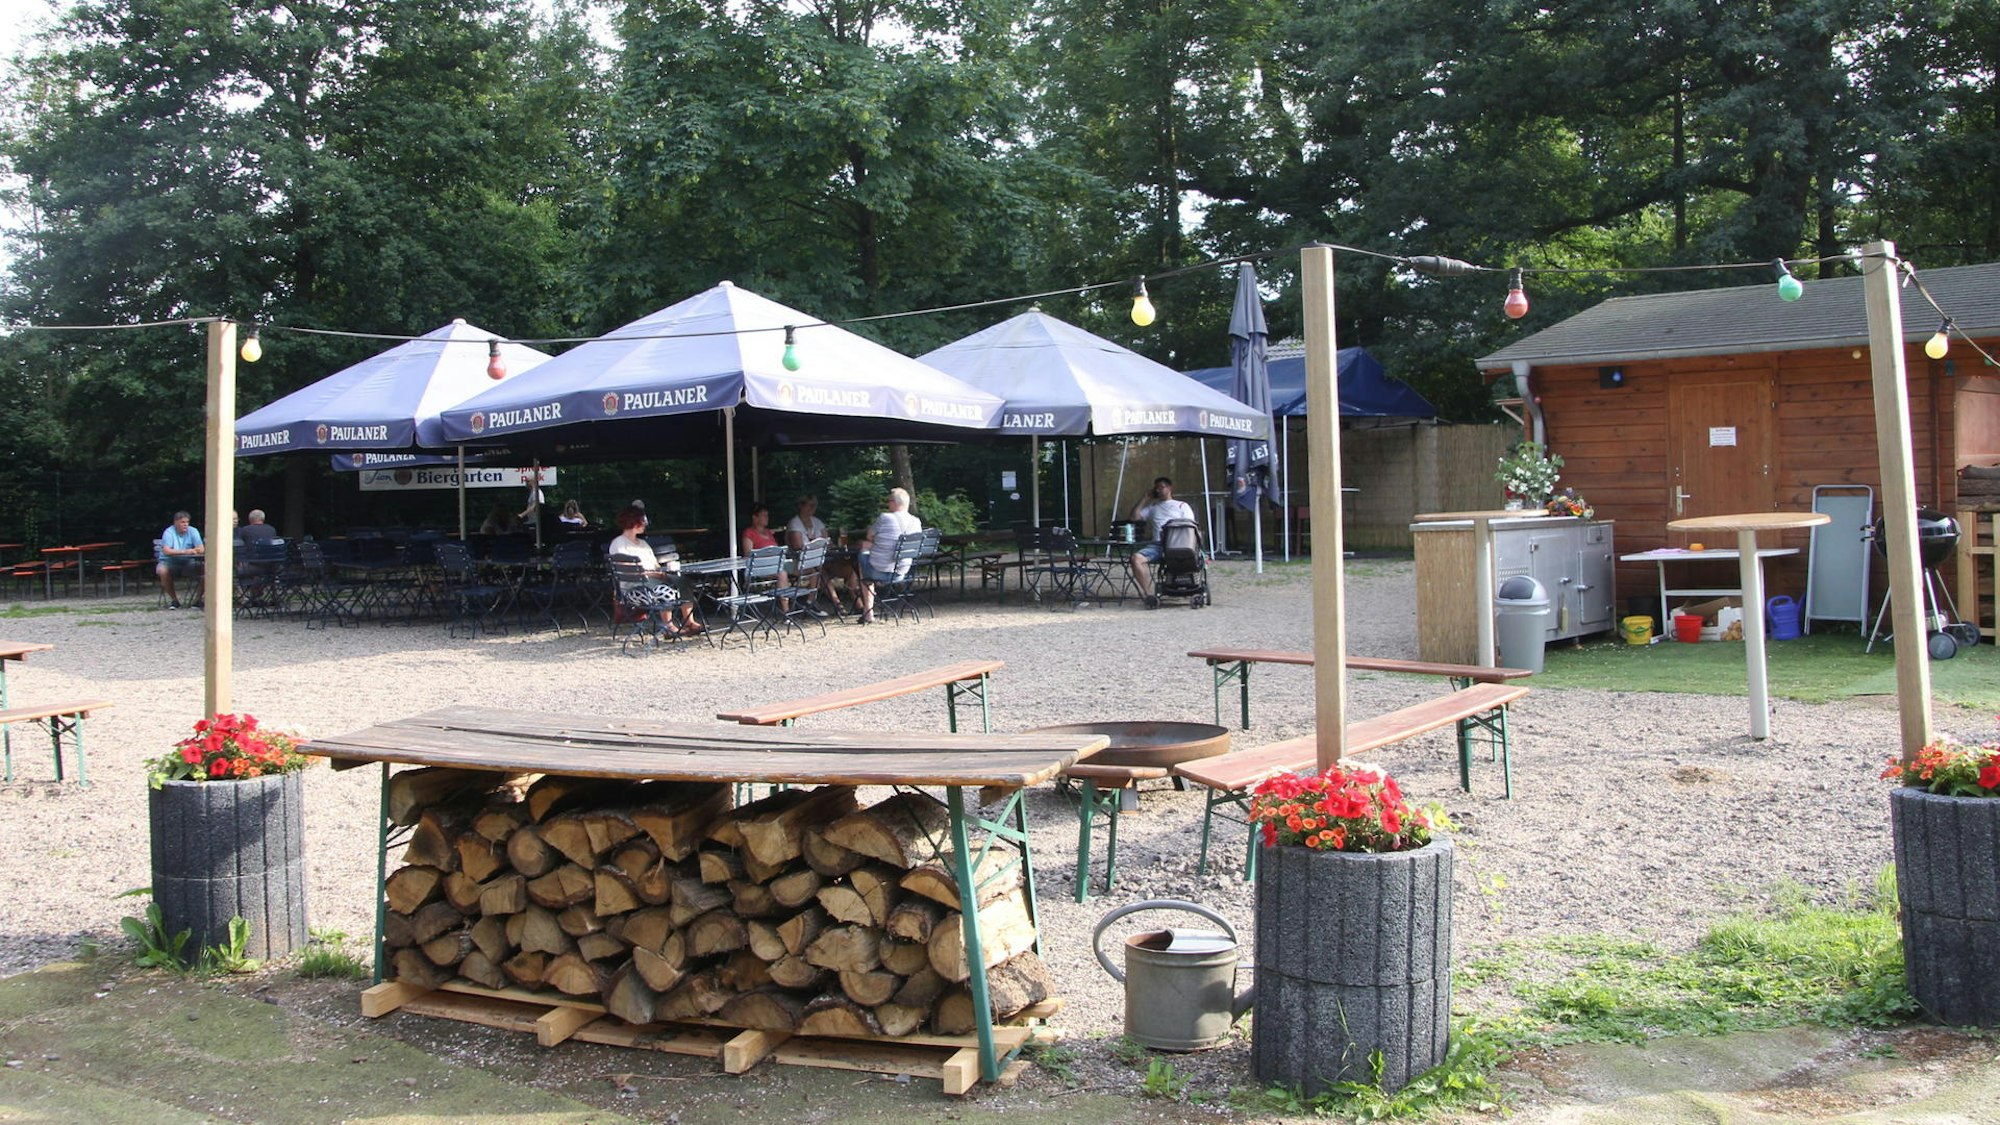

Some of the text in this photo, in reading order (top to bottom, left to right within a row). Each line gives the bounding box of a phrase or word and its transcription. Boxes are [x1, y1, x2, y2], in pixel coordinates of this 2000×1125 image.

[623, 384, 708, 411] PAULANER
[796, 385, 871, 408] PAULANER
[488, 402, 562, 429] PAULANER
[919, 399, 984, 421] PAULANER
[1003, 412, 1055, 428] LANER
[1124, 410, 1176, 425] PAULANER
[330, 425, 388, 441] PAULANER
[1209, 413, 1253, 433] PAULANER
[241, 429, 290, 449] PAULANER
